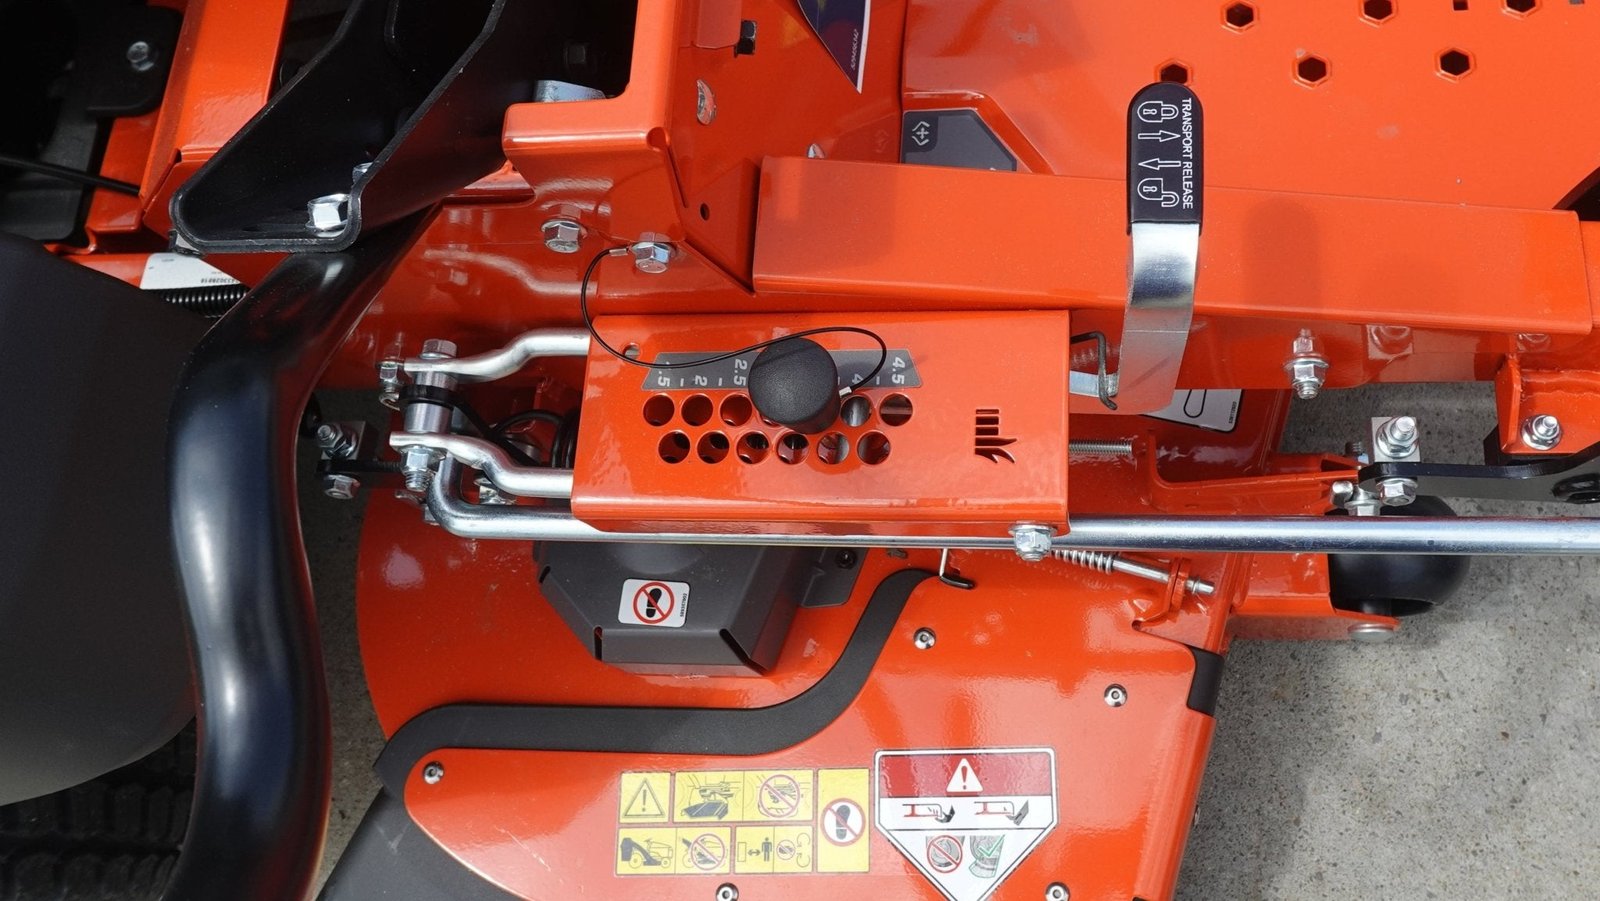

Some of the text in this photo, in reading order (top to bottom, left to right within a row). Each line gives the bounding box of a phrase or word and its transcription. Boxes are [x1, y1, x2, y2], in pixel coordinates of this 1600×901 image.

[1182, 97, 1193, 210] TRANSPORT RELEASE
[694, 374, 708, 387] 2
[733, 358, 748, 386] 2.5
[851, 373, 864, 385] 4
[891, 356, 906, 384] 4.5
